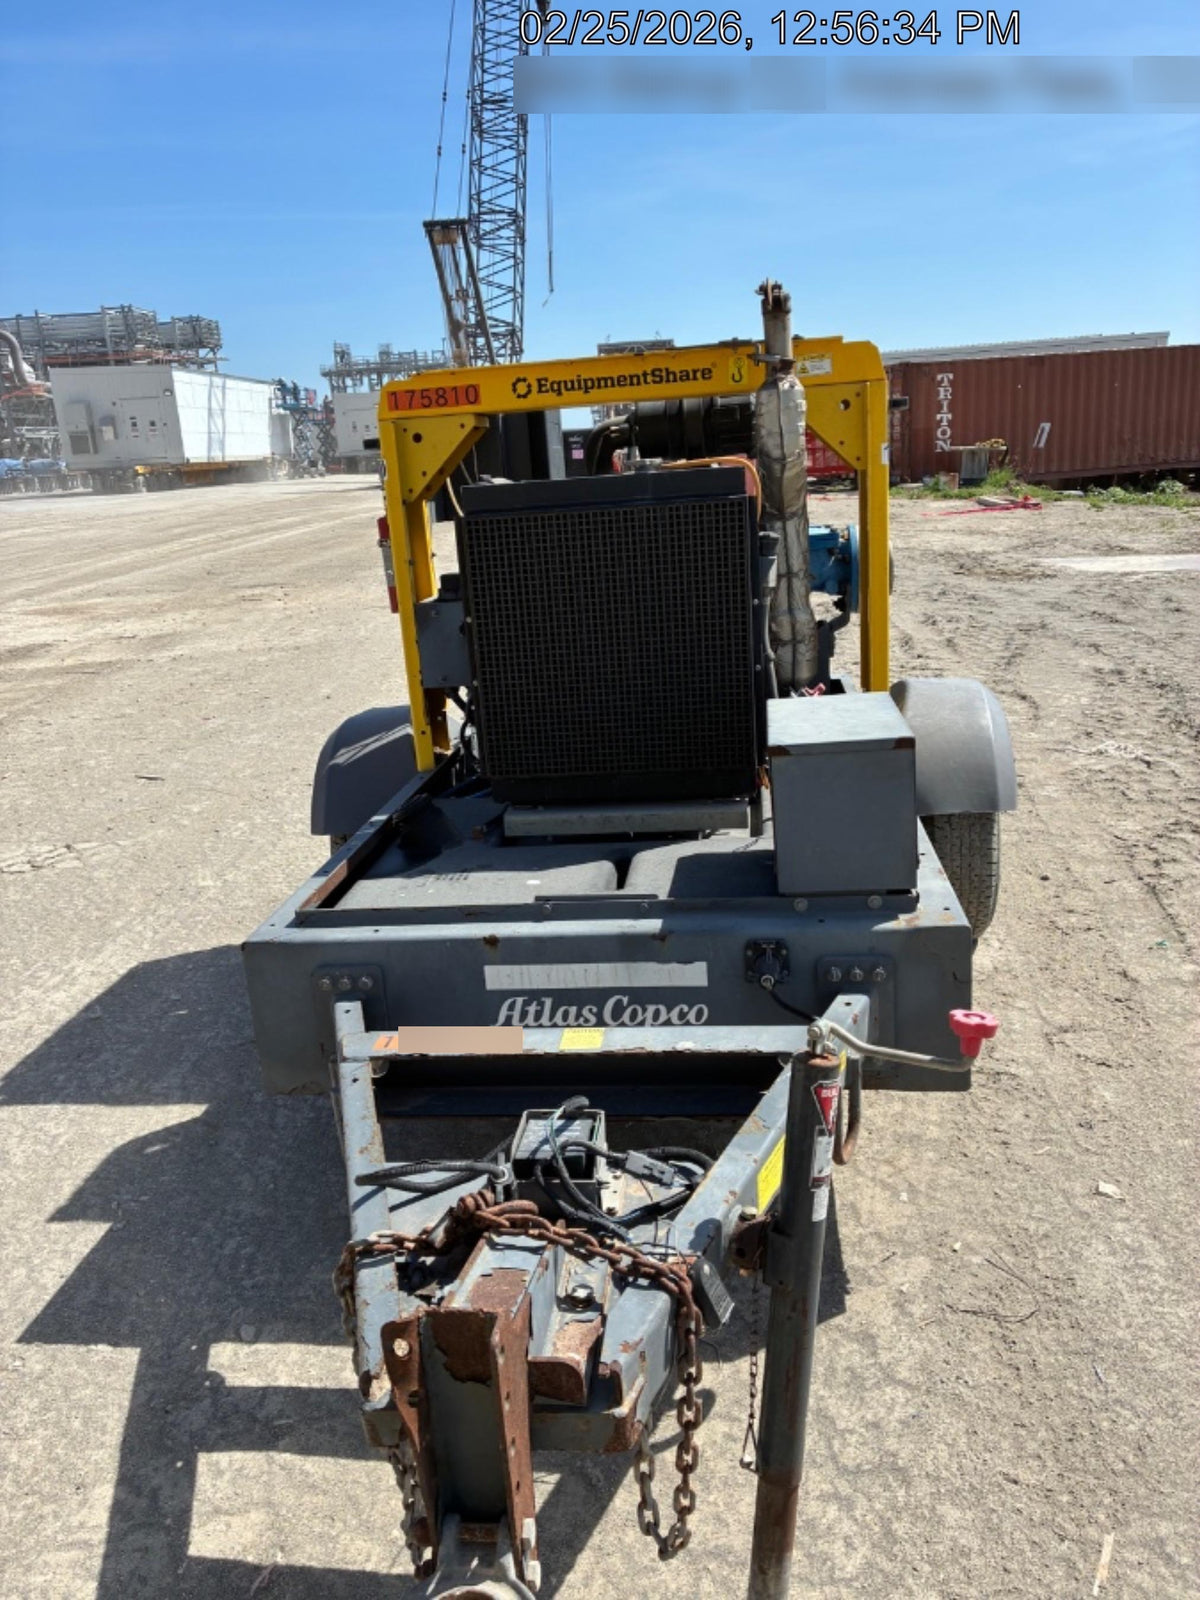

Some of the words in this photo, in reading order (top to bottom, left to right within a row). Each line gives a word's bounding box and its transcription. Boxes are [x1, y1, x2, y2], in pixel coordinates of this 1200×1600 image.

[536, 367, 713, 396] EquipmentShare
[390, 384, 479, 411] 175810
[935, 373, 954, 453] TRITON
[493, 996, 599, 1027] Atlas
[602, 994, 709, 1027] Copco
